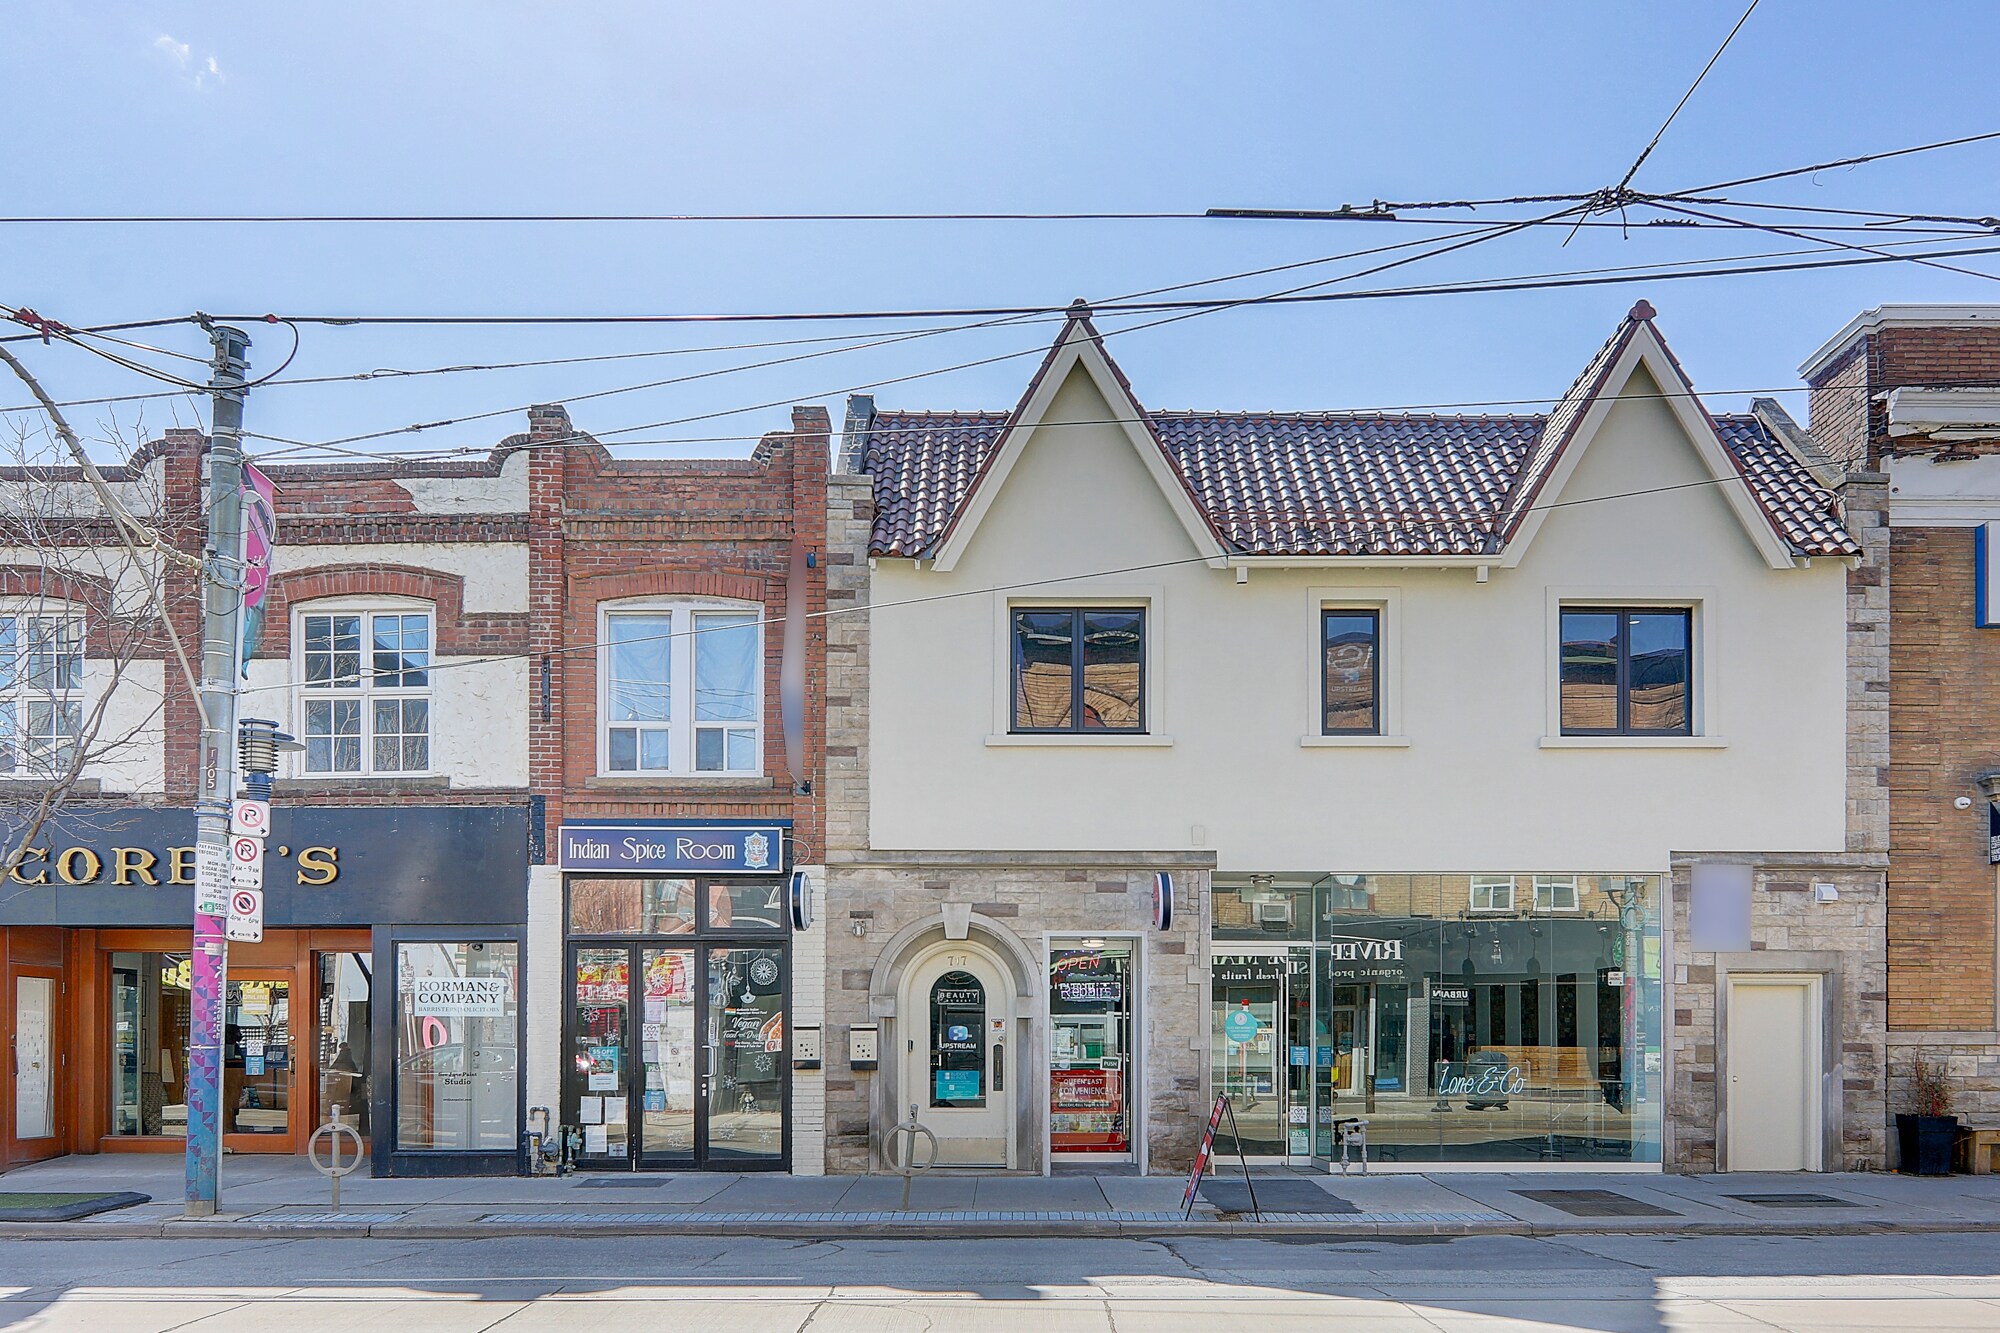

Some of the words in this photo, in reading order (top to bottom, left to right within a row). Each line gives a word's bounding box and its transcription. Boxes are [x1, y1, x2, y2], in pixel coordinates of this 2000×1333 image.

[569, 837, 610, 859] Indian
[620, 837, 666, 863] Spice
[676, 838, 735, 860] Room
[1057, 956, 1101, 971] OPEN
[418, 992, 500, 1004] COMPANY
[1061, 984, 1112, 999] Repairs
[731, 1016, 763, 1031] Vegan
[1500, 1066, 1527, 1095] Co
